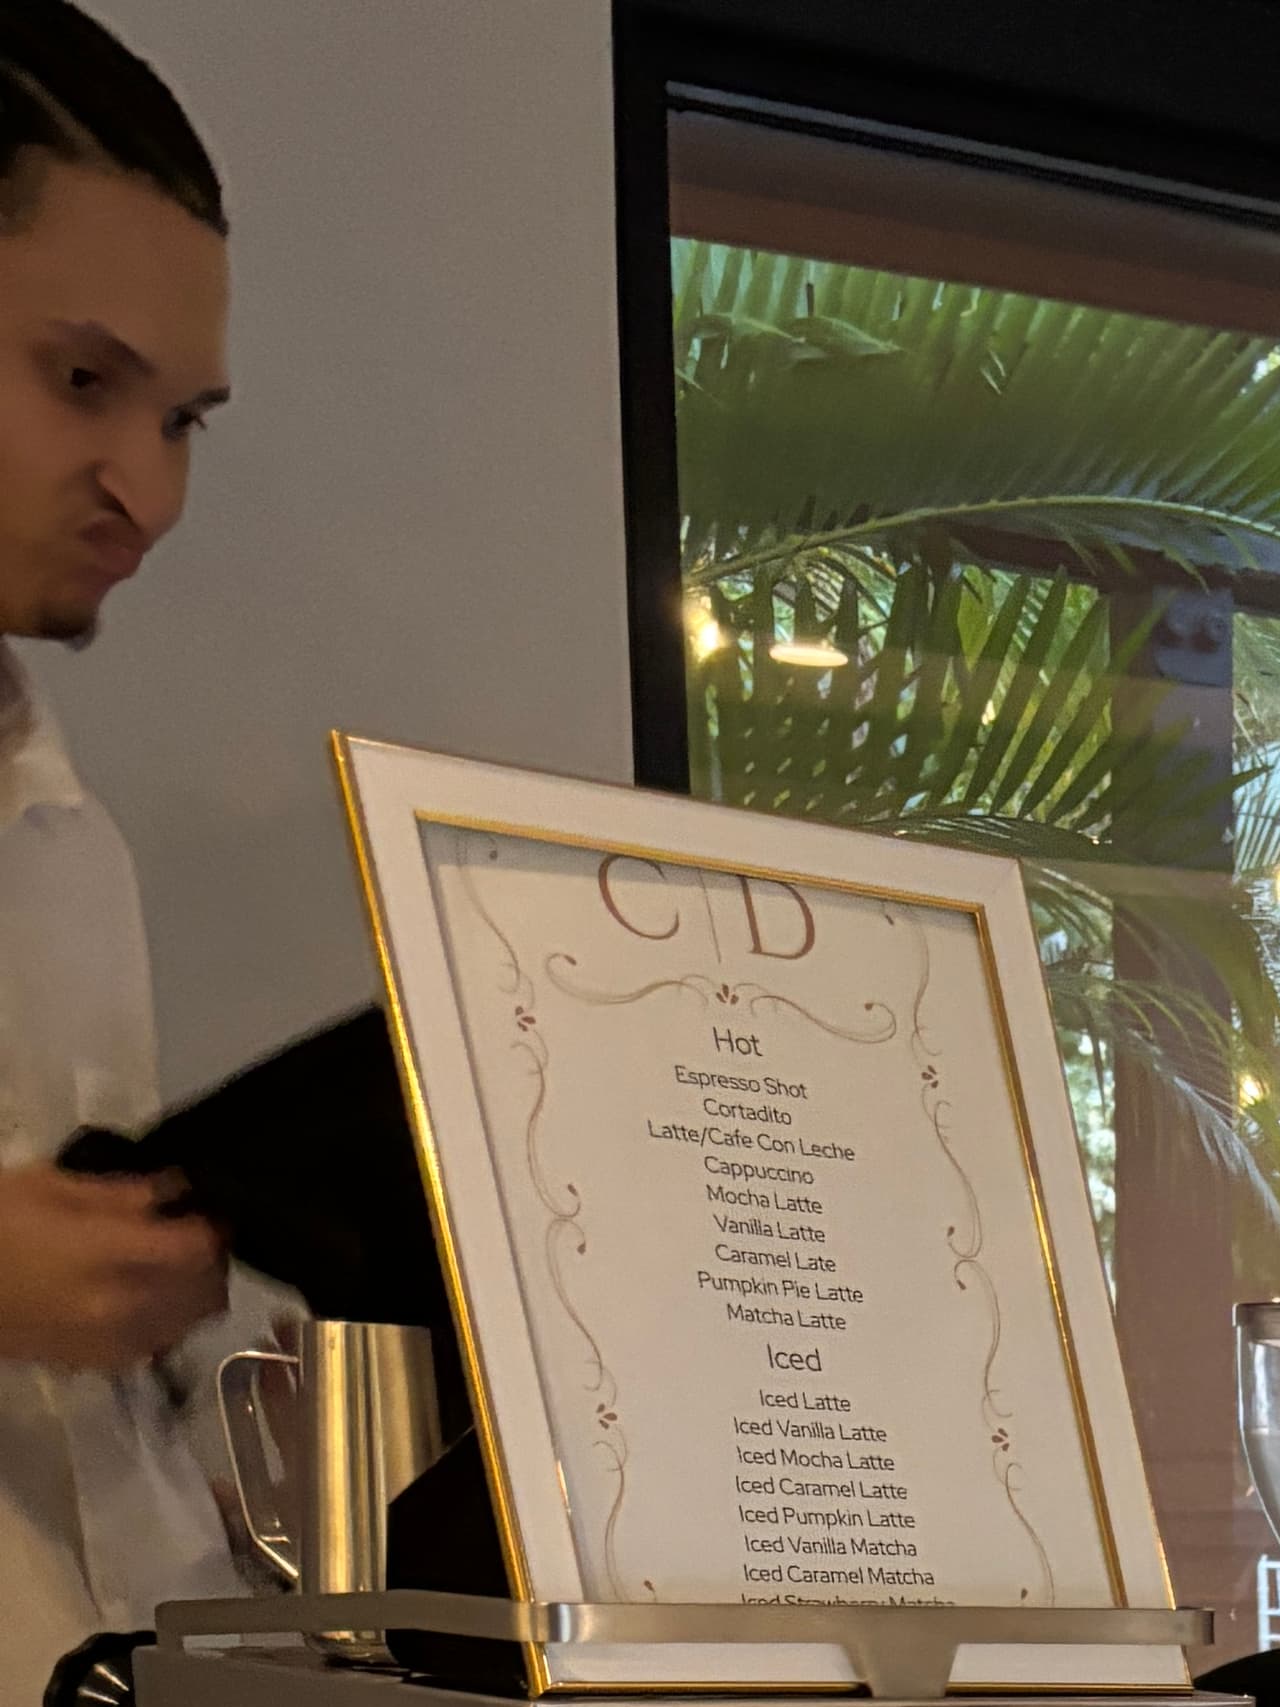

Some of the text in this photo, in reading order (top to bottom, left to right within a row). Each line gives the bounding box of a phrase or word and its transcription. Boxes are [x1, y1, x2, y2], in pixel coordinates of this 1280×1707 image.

[712, 1027, 763, 1056] Hot
[674, 1065, 808, 1099] Espresso Shot
[703, 1098, 792, 1125] Cortadito
[647, 1120, 856, 1161] Latte/Cafe Con Leche
[704, 1156, 815, 1184] Cappuccino
[706, 1185, 823, 1214] Mocha Latte
[713, 1214, 826, 1243] Vanilla Latte
[715, 1244, 836, 1272] Caramel Late
[697, 1271, 864, 1303] Pumpkin Pie Latte
[727, 1303, 847, 1331] Matcha Latte
[767, 1343, 823, 1372] Iced
[759, 1389, 852, 1412] Iced Latte
[734, 1417, 888, 1443] Iced Vanilla Latte
[737, 1446, 896, 1471] Iced Mocha Latte
[735, 1475, 908, 1500] Iced Caramel Latte
[738, 1504, 916, 1530] Iced Pumpkin Latte
[744, 1535, 918, 1557] Iced Vanilla Matcha
[743, 1563, 935, 1586] Iced Caramel Matcha
